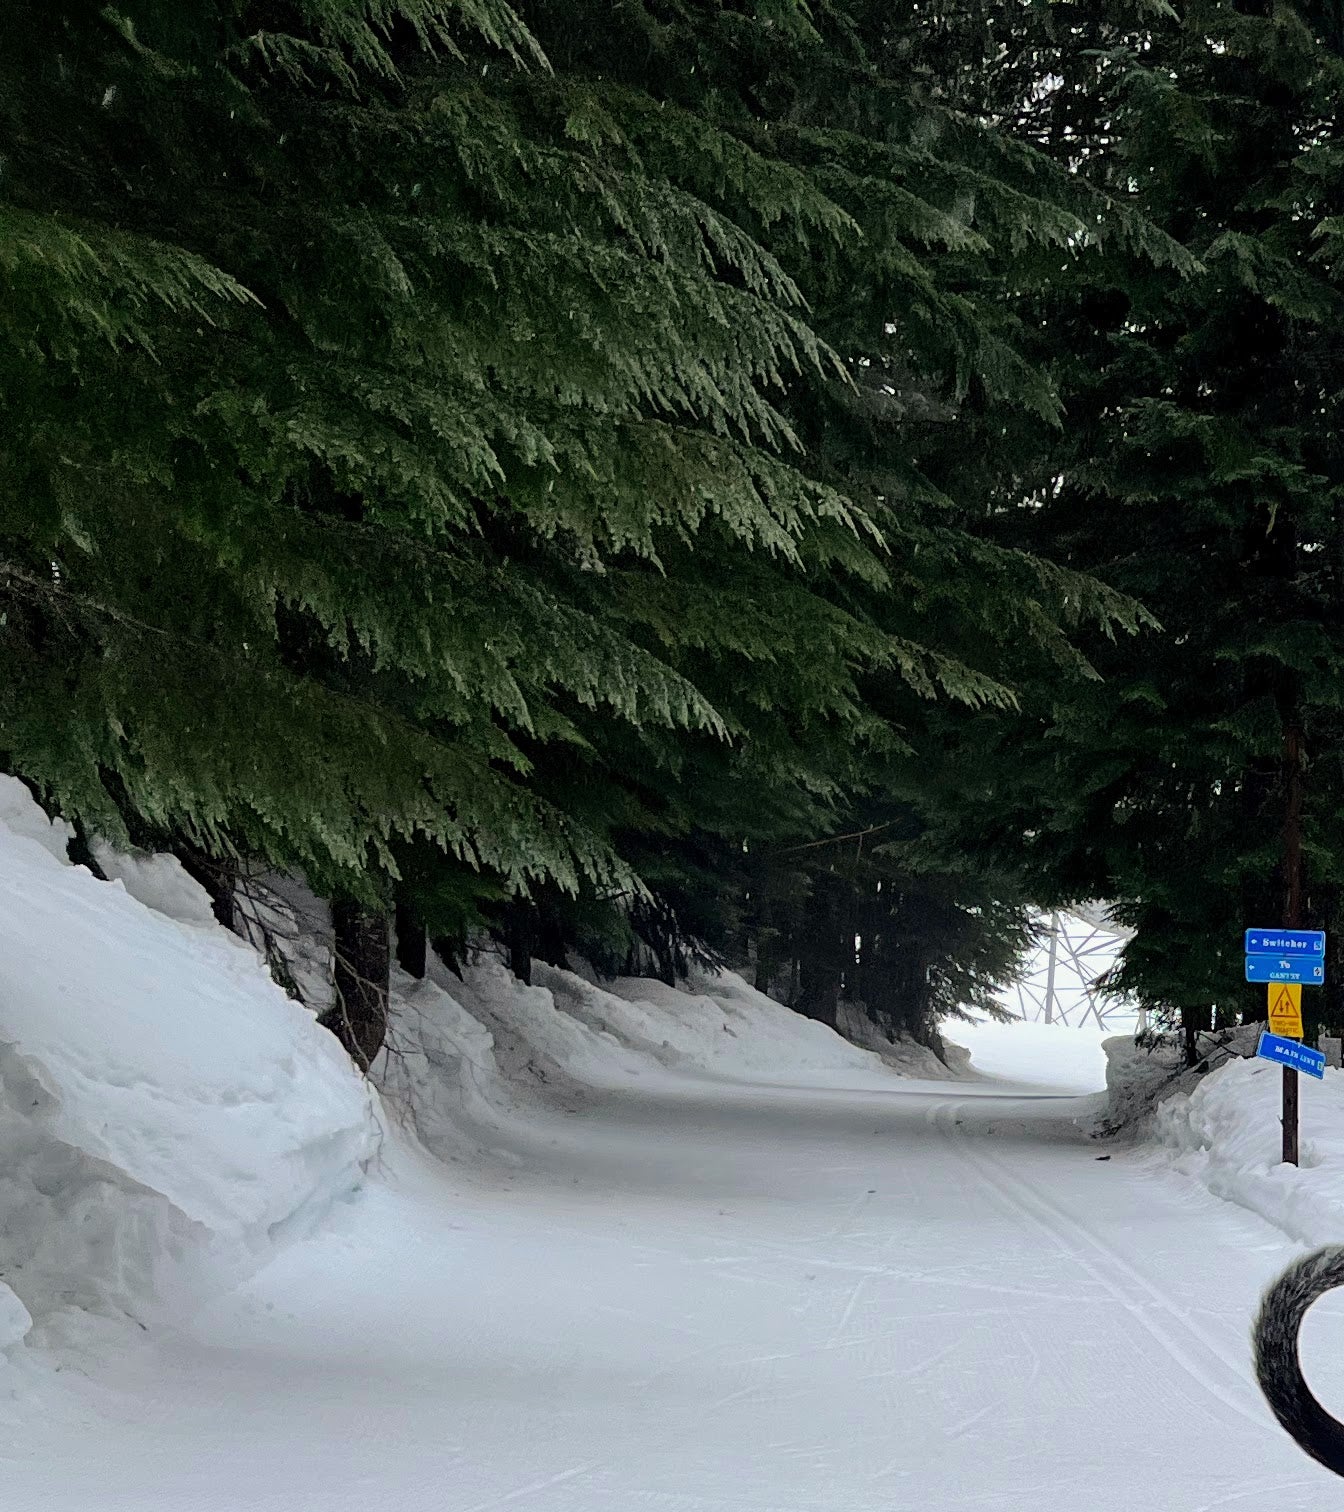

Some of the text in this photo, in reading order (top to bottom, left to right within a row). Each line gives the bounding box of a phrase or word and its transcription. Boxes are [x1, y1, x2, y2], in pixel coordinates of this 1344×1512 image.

[1262, 938, 1308, 948] Switcher
[1279, 960, 1291, 968] To
[1275, 1046, 1315, 1067] MAIN LINE
